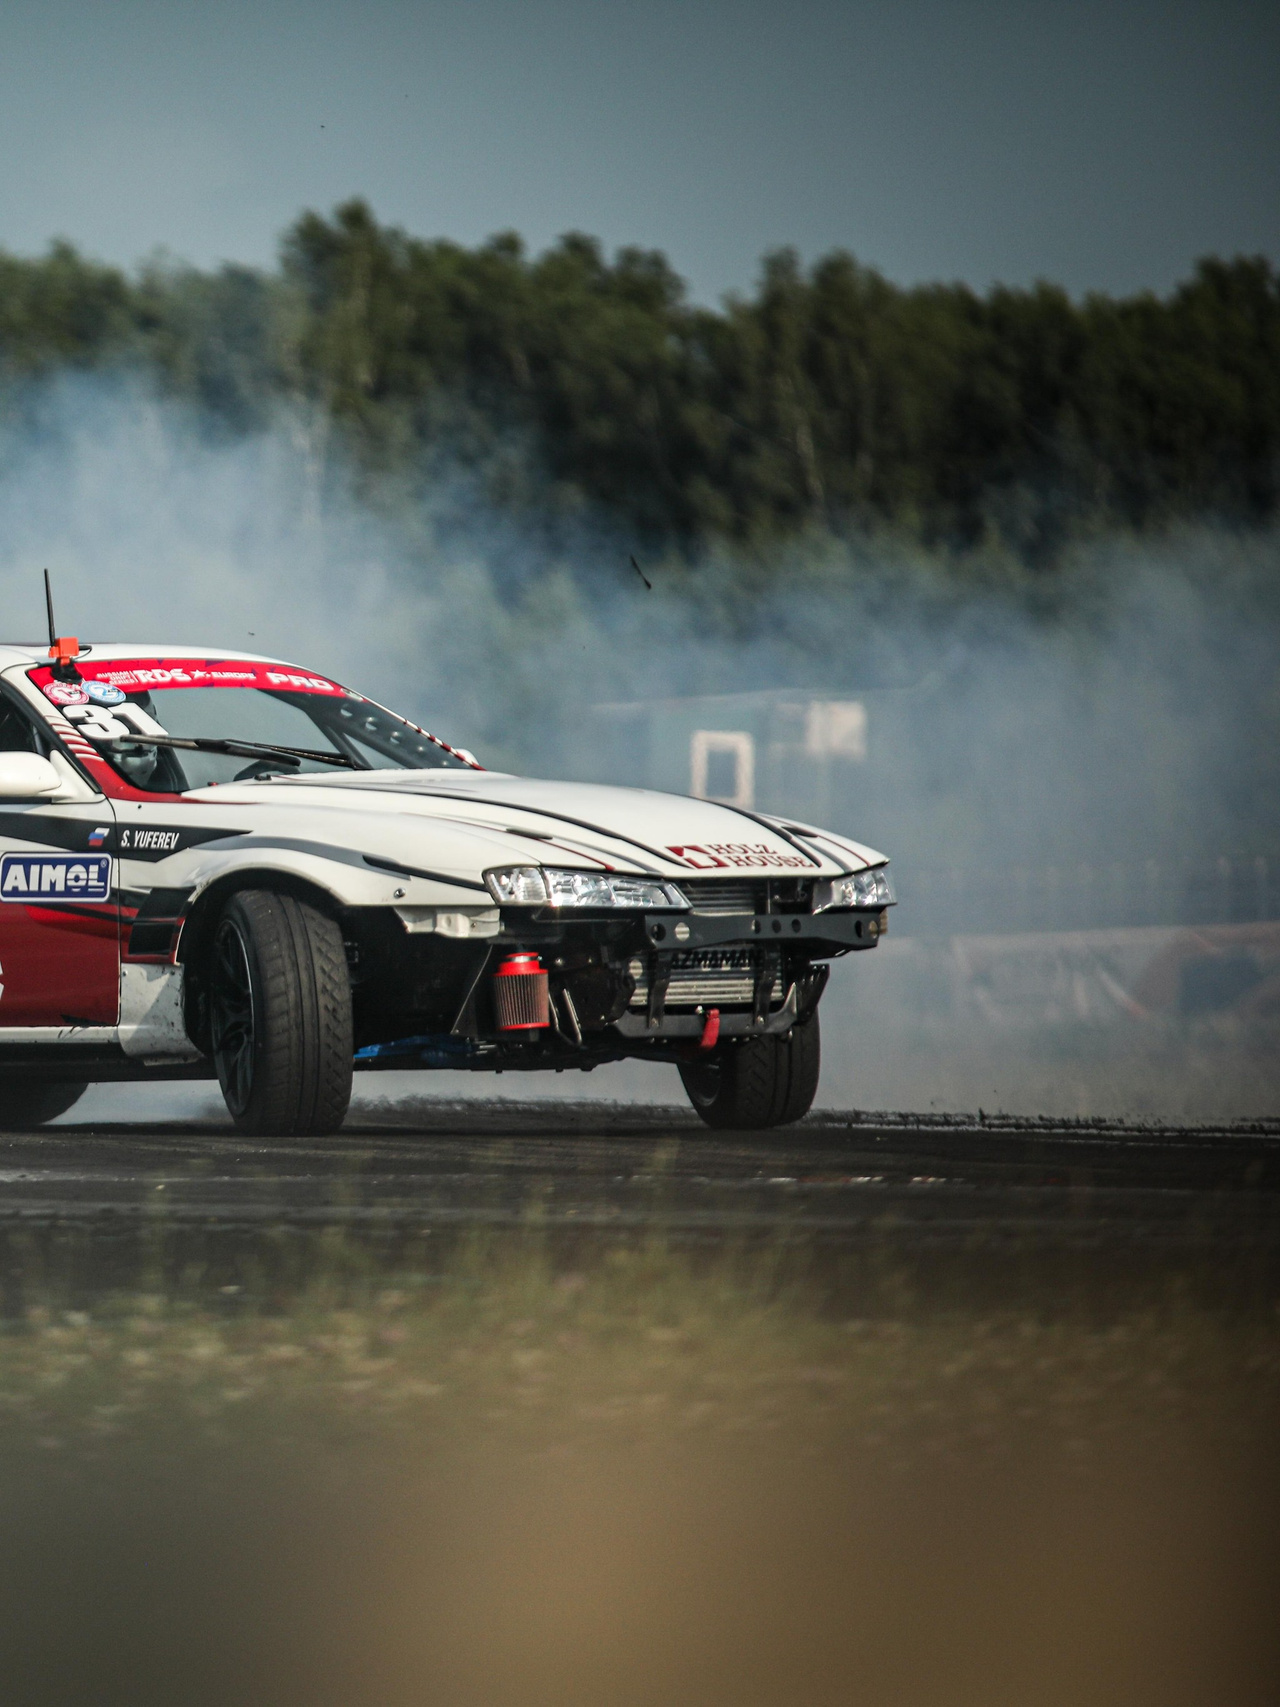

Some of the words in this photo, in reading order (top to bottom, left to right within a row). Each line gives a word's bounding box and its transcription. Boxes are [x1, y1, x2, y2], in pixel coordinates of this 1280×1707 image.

[133, 668, 192, 684] RDS
[211, 671, 256, 680] EUROPE
[266, 671, 334, 690] PRO
[63, 702, 169, 739] 31
[121, 830, 131, 847] S.
[134, 831, 179, 849] YUFEREV
[706, 844, 778, 854] HOLZ
[724, 855, 814, 867] HOUSE
[2, 864, 105, 892] AIMOL
